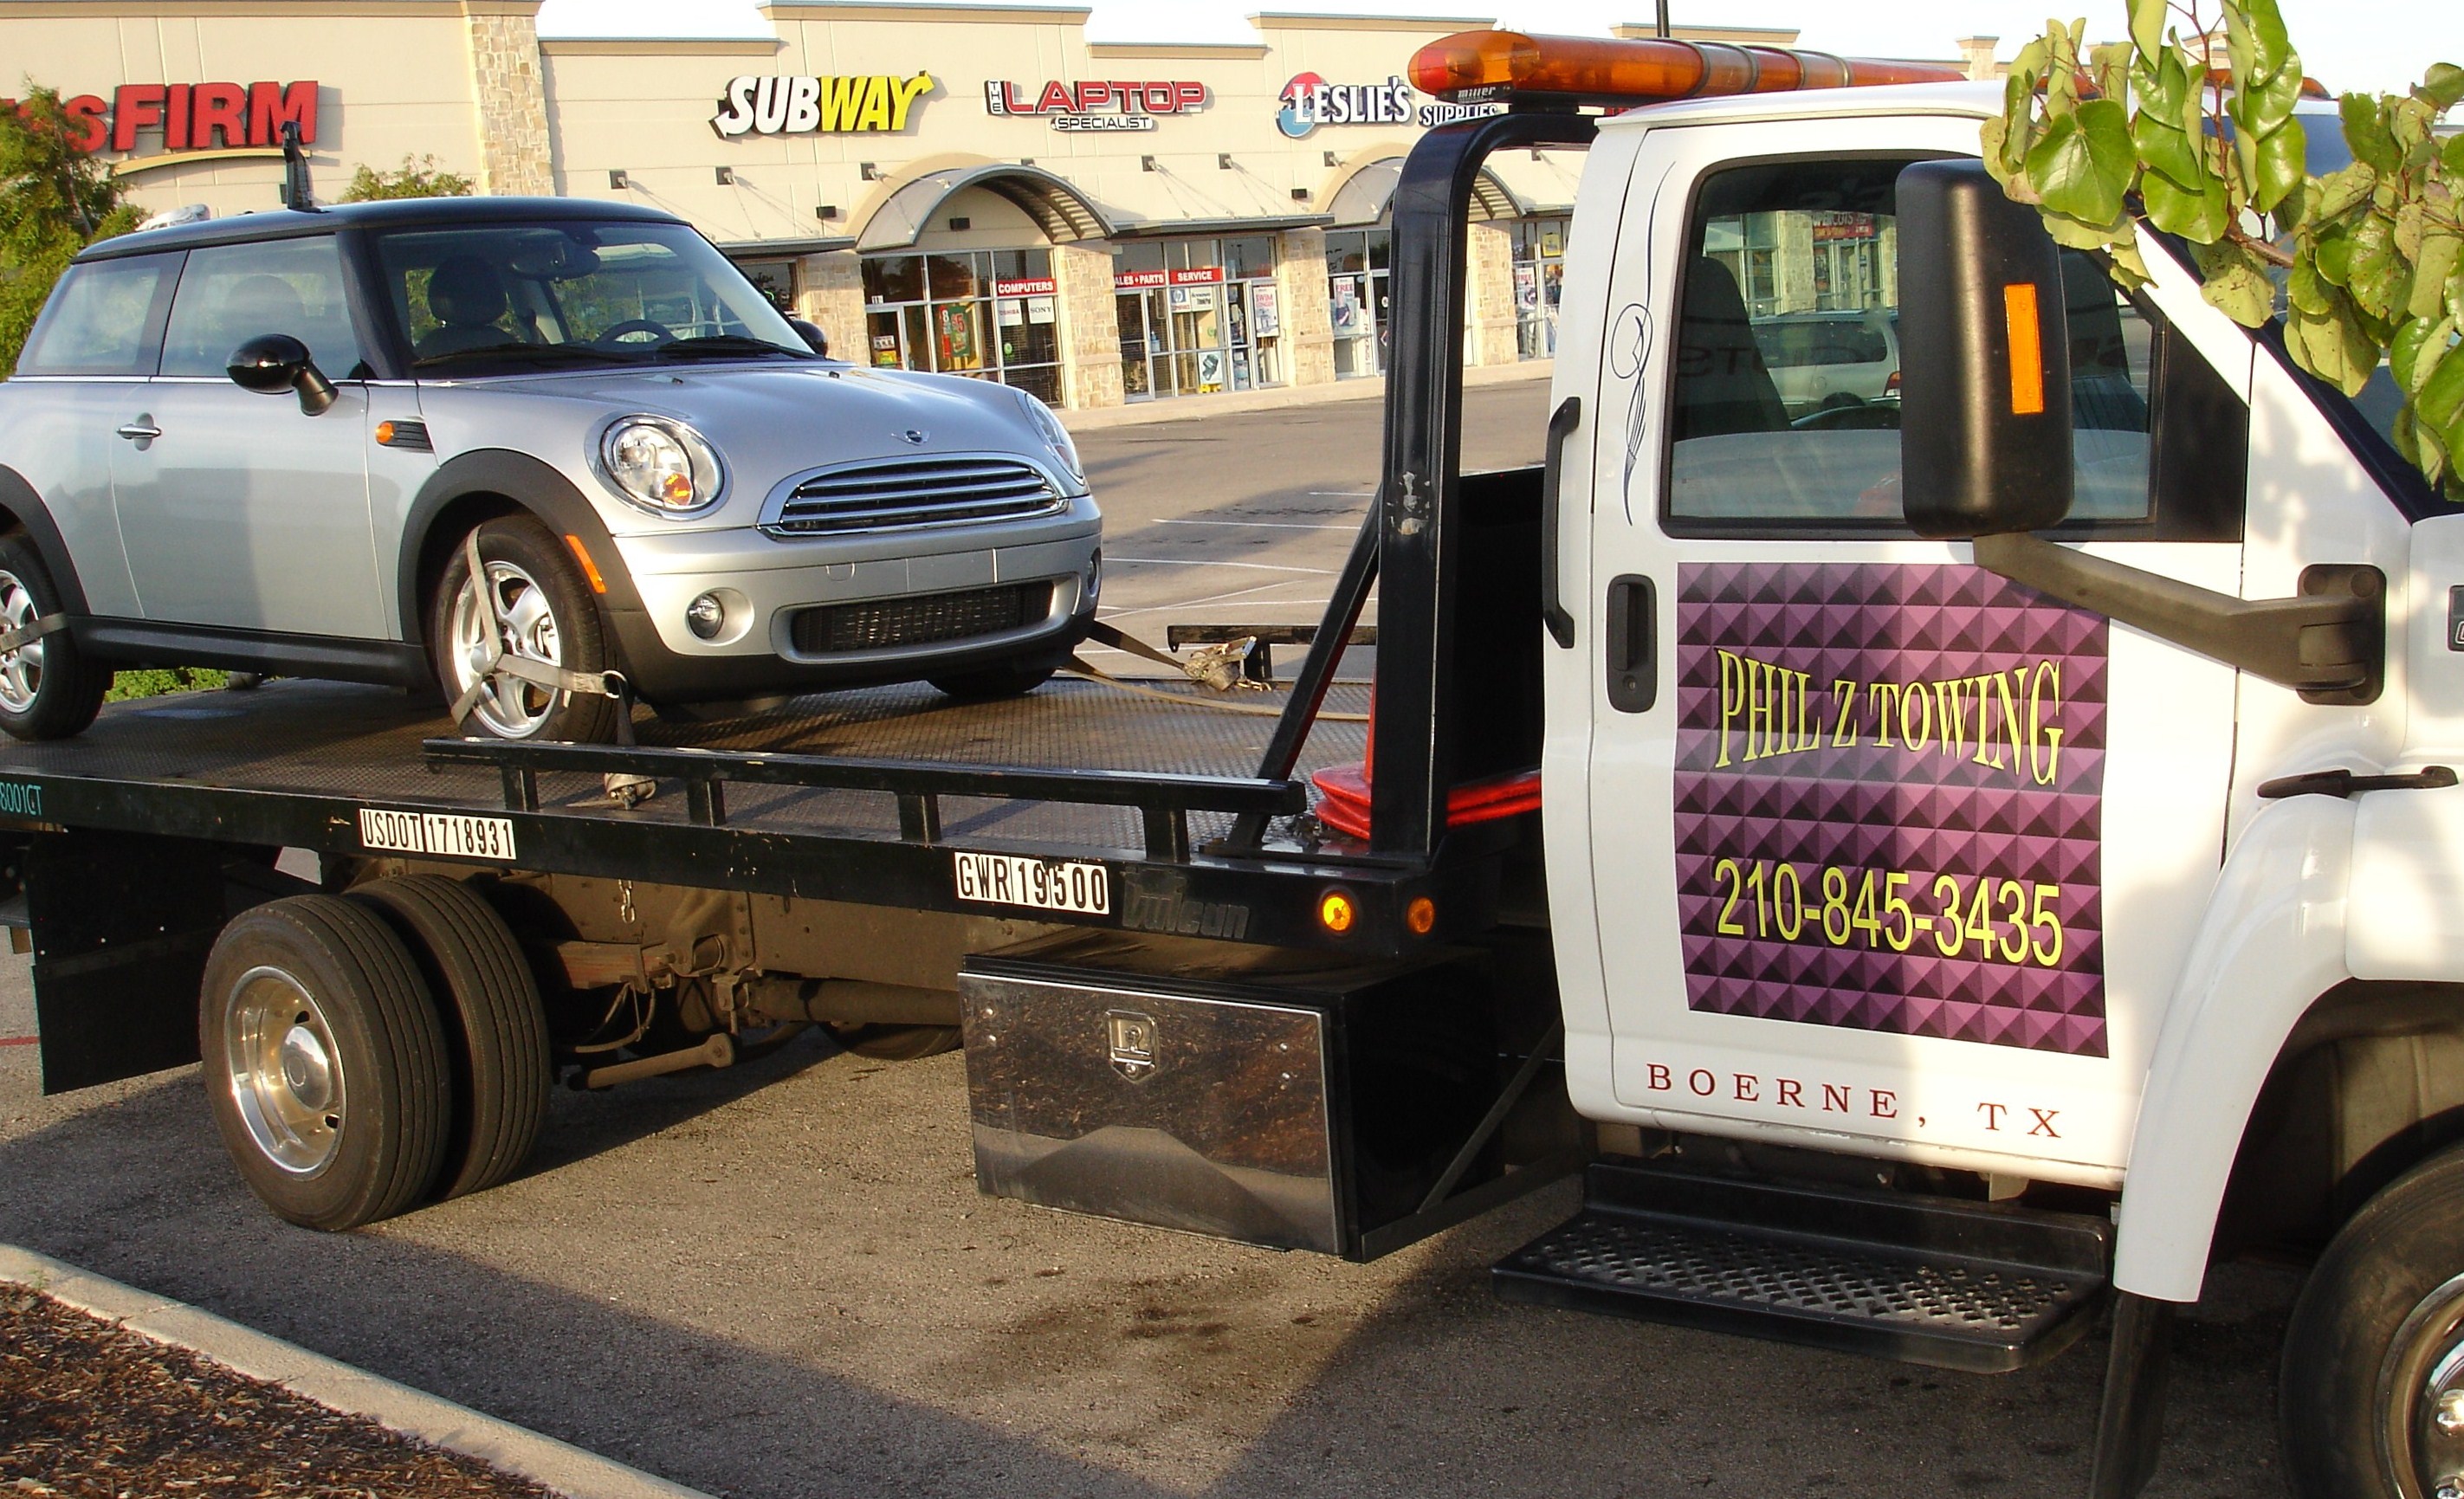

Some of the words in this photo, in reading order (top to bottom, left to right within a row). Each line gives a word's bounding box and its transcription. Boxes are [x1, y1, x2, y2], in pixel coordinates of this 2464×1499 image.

[715, 72, 935, 139] SUBWAY
[990, 81, 1001, 112] THE
[1004, 81, 1206, 113] LAPTOP
[1293, 75, 1411, 124] LESLIE'S
[1458, 87, 1496, 98] miller
[1057, 117, 1149, 129] SPECIALIST
[998, 281, 1054, 294] COMPUTERS
[1116, 275, 1134, 286] ALES
[1139, 274, 1164, 284] PARTS
[1177, 271, 1213, 282] SERVICE
[1030, 306, 1051, 314] SONY
[1715, 649, 1820, 768] PHIL
[1832, 679, 1857, 747] Z
[1869, 660, 2064, 785] TOWING
[362, 811, 419, 850] USDOT
[428, 817, 512, 857] 1718931
[959, 855, 1011, 901] GWR
[1018, 861, 1106, 910] 19500
[1715, 859, 2063, 967] 210-845-3435
[1646, 1063, 1925, 1128] BOERNE,
[1977, 1102, 2061, 1139] TX
